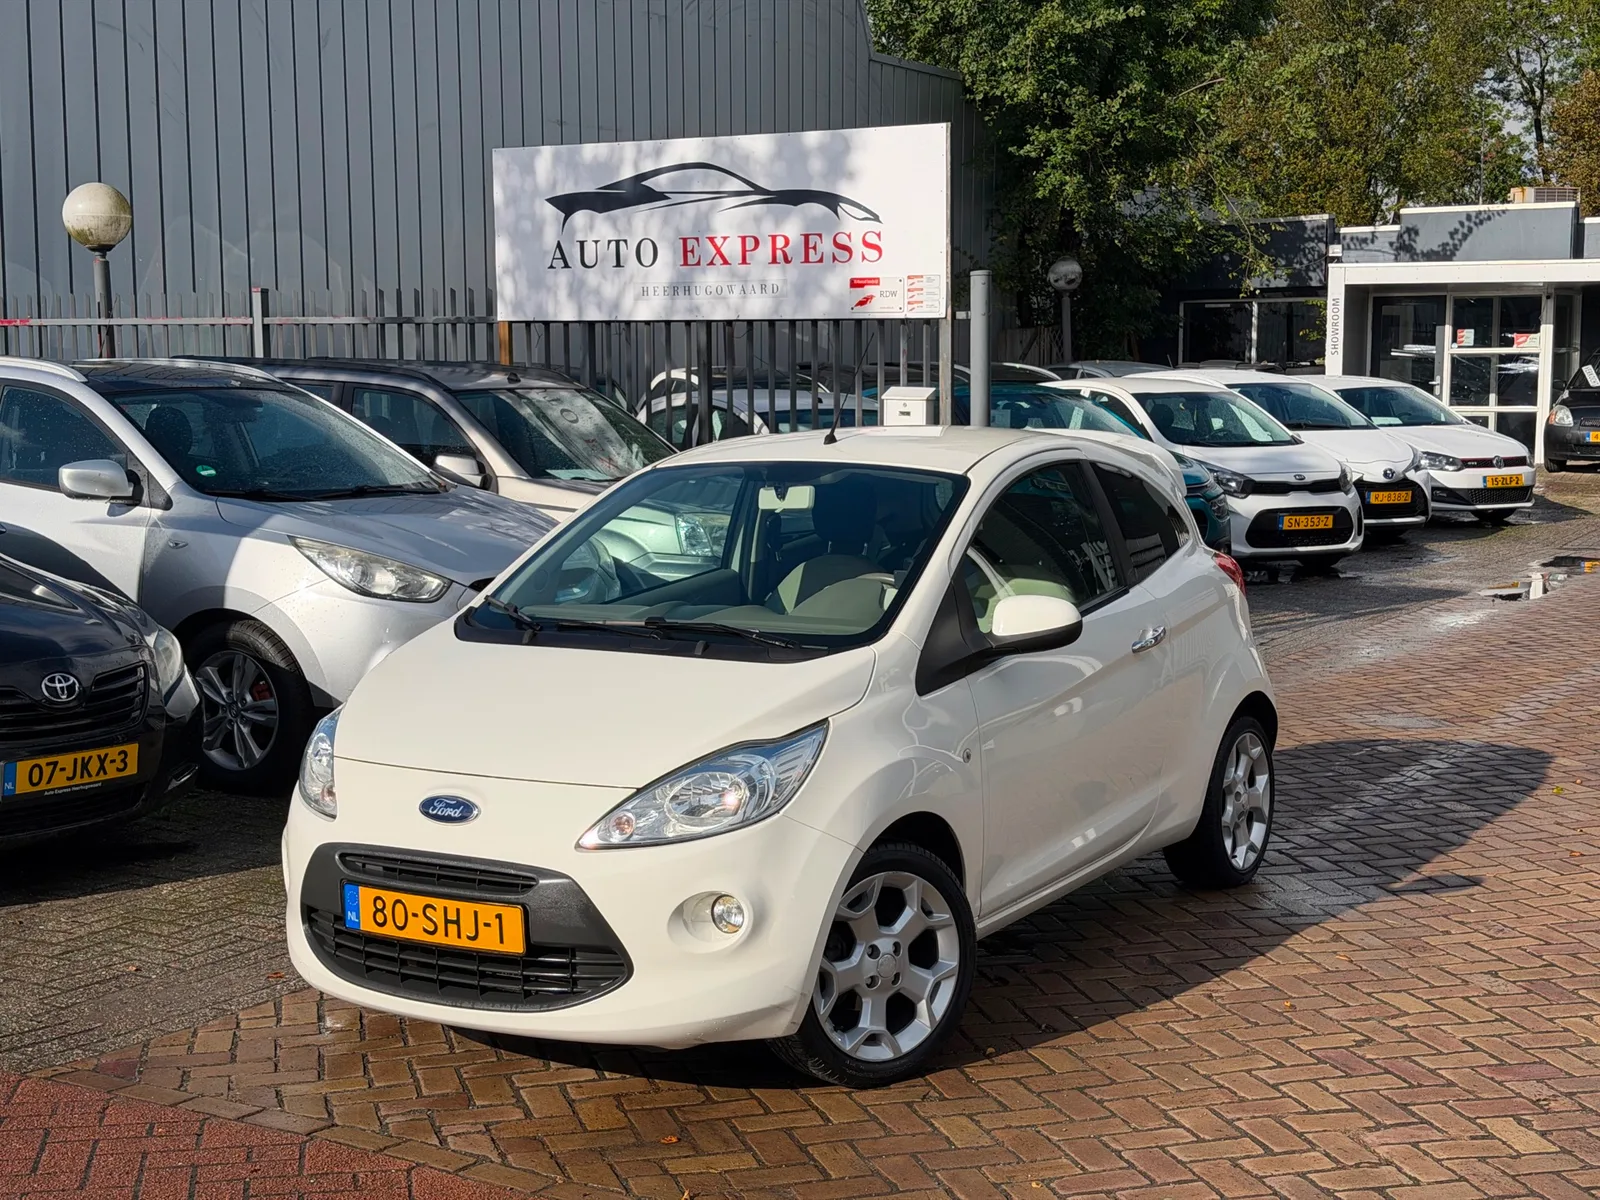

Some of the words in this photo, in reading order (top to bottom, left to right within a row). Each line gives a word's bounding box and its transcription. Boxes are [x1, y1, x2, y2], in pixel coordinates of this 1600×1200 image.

[547, 237, 659, 269] AUTO
[678, 230, 884, 267] EXPRESS
[641, 282, 780, 298] HEERHUGOWAARD
[879, 290, 898, 298] RDW
[1331, 297, 1340, 355] SHOWROOM
[1491, 476, 1520, 485] 15-ZLF-2
[1374, 492, 1409, 503] RJ-838-Z
[1287, 516, 1329, 528] SN-353-Z
[28, 750, 129, 787] 07-JKX-3
[4, 782, 14, 790] NL
[428, 798, 464, 818] Ford
[347, 910, 359, 922] NL
[371, 895, 504, 945] 80-SHJ-1
